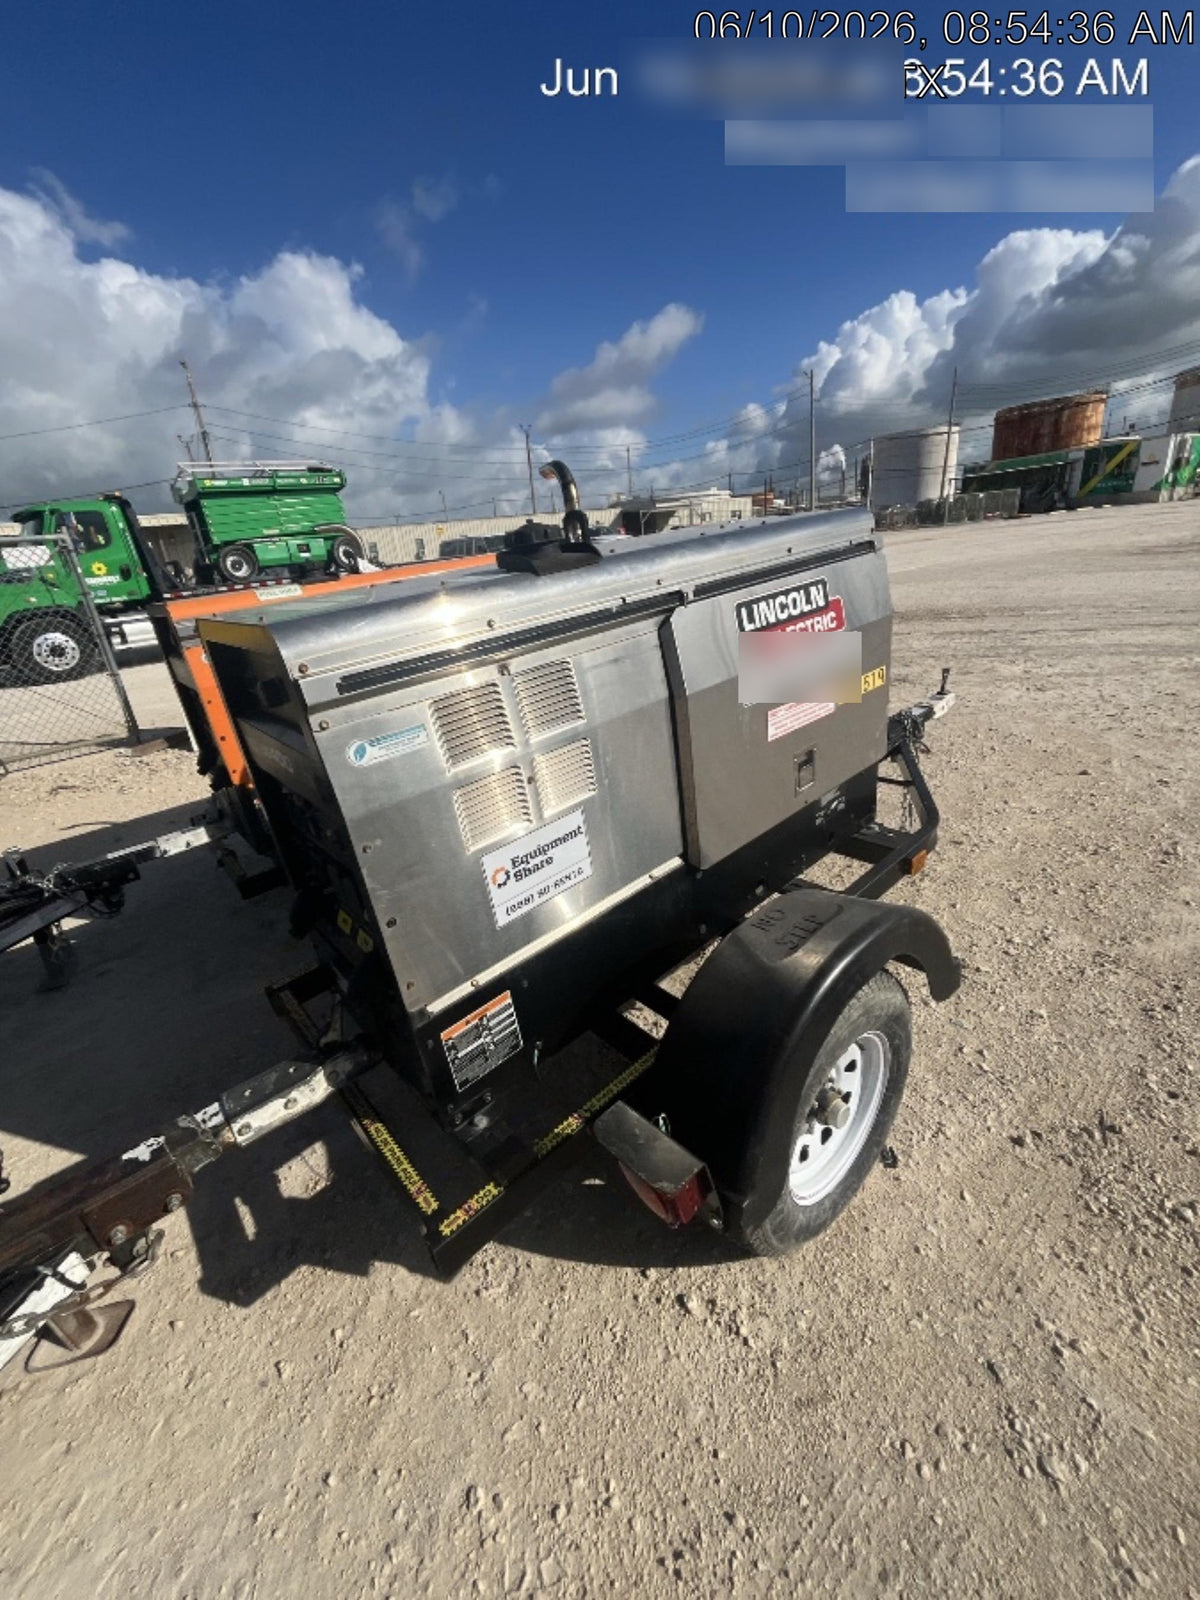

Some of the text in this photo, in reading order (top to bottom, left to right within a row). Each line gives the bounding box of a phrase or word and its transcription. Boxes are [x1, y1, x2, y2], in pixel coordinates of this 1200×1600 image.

[740, 583, 826, 632] LINCOLN
[510, 824, 584, 871] Equipment
[512, 855, 554, 883] Share
